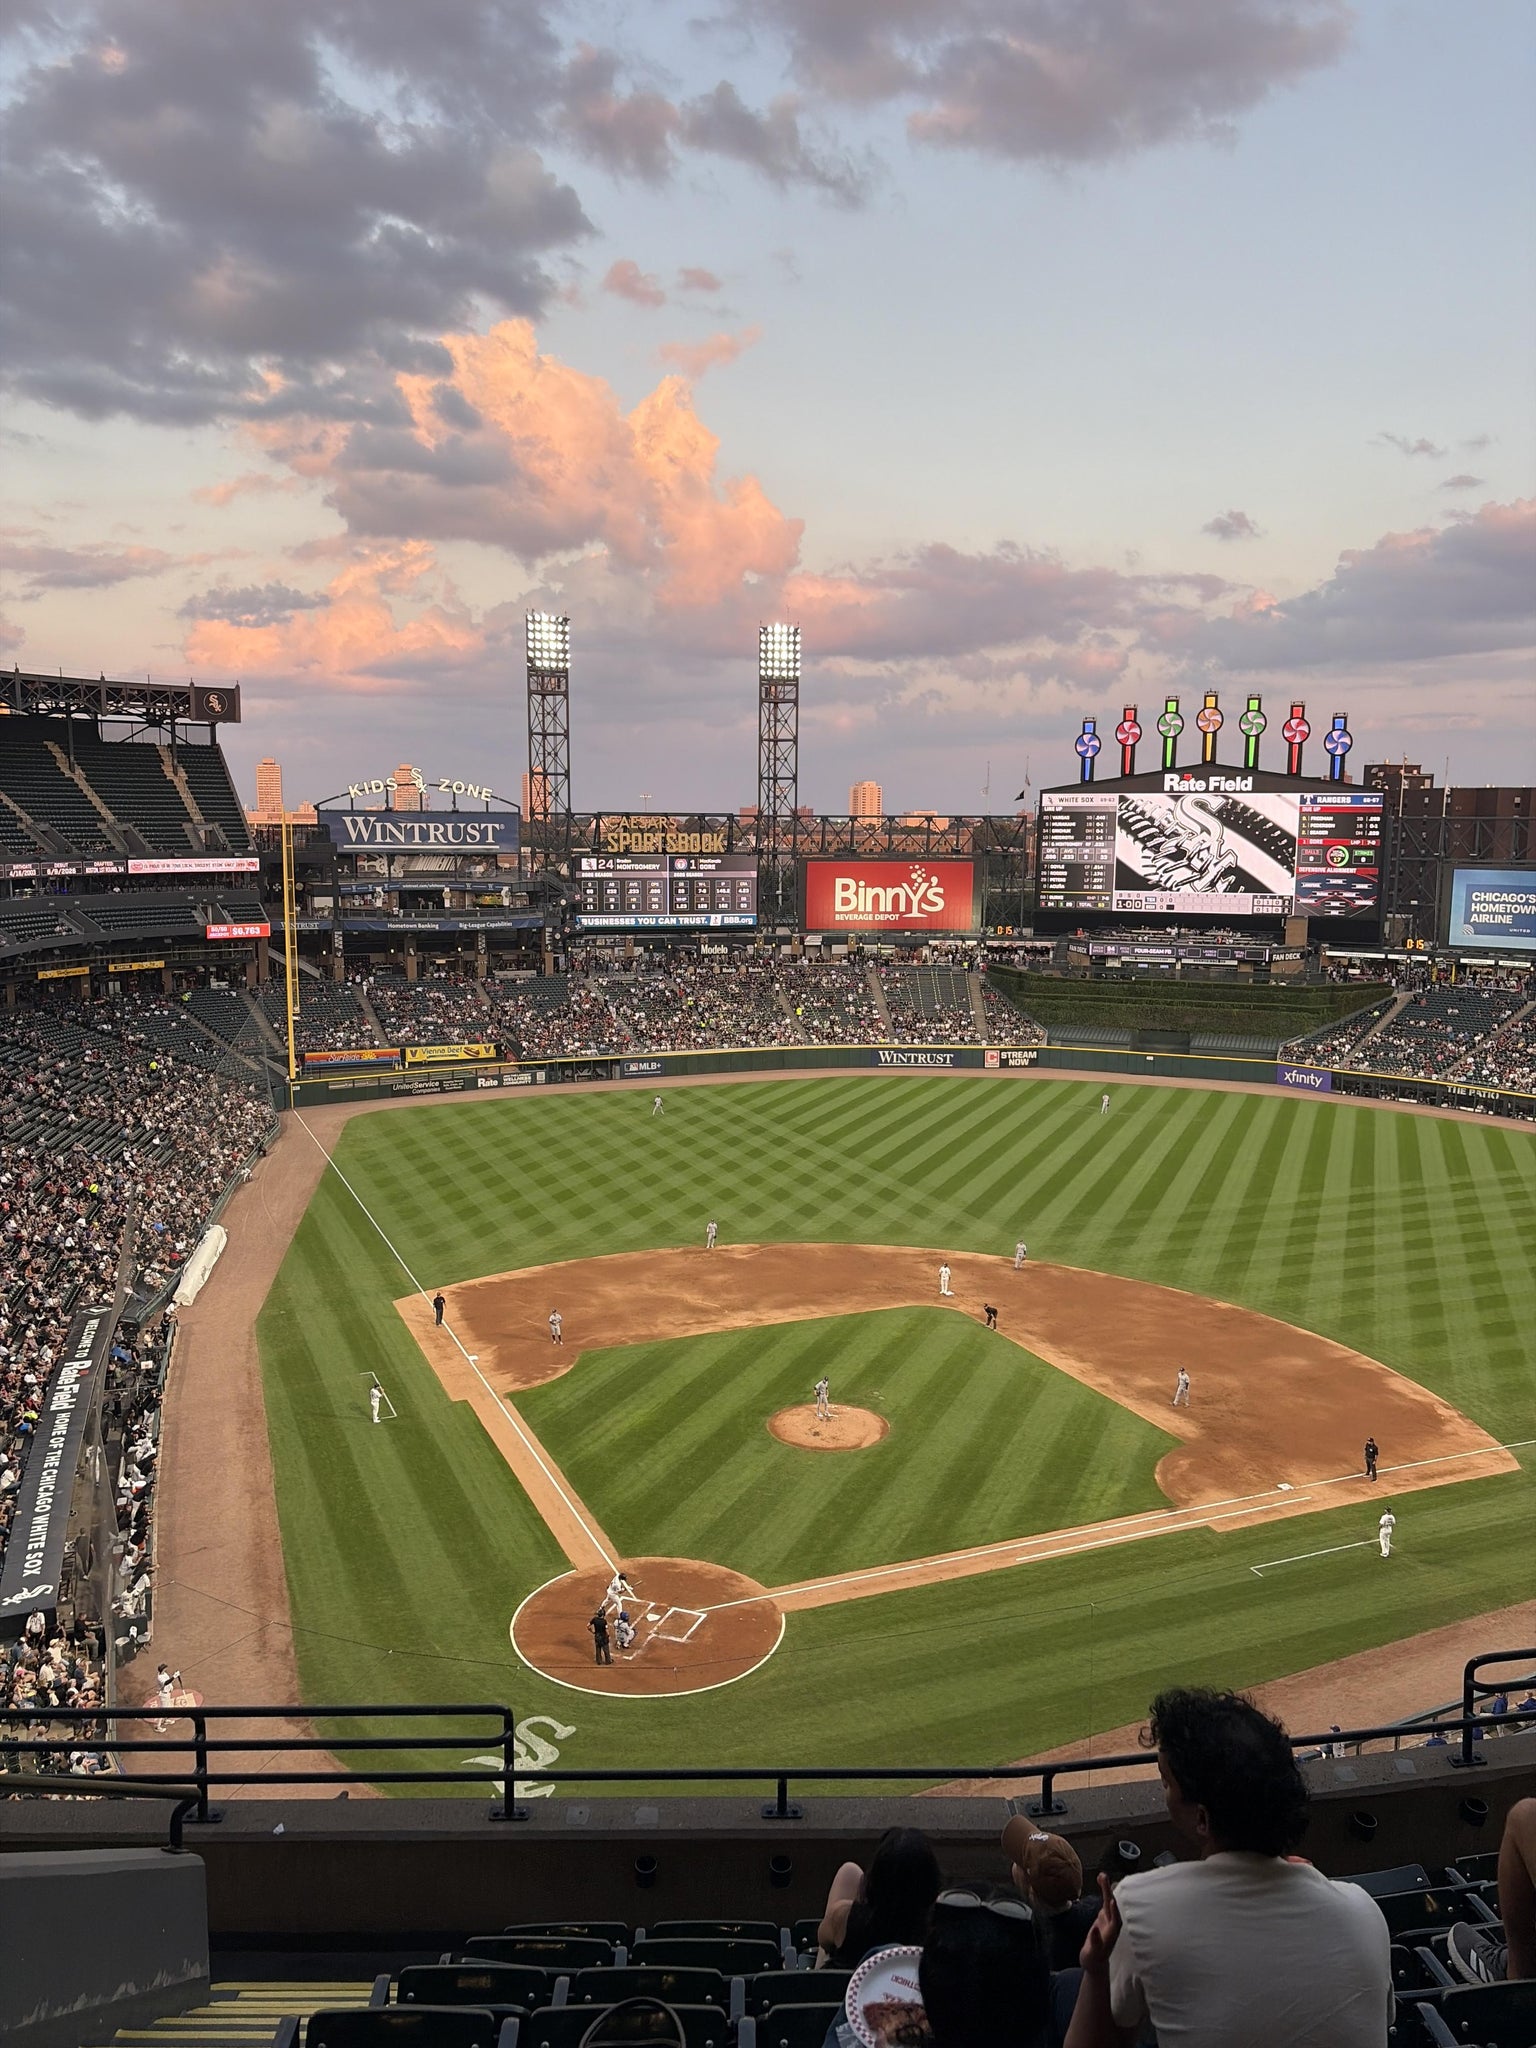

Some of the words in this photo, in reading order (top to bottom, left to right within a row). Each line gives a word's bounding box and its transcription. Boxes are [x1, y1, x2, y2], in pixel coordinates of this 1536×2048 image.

[349, 777, 398, 799] KIDS
[438, 778, 493, 802] ZONE
[1164, 774, 1207, 792] Rate
[1208, 776, 1253, 792] Field
[342, 816, 500, 844] WINTRUST
[608, 816, 678, 829] CAESARS
[608, 832, 726, 854] SPORTSBOOK
[598, 859, 614, 870] 24
[690, 860, 696, 870] 1
[1472, 892, 1536, 904] CHICAGO'S
[1470, 914, 1513, 924] AIRLINE
[701, 944, 728, 954] Modelo
[1406, 938, 1424, 950] 0:15
[640, 1062, 661, 1070] MLB+
[878, 1051, 954, 1064] WINTRUST
[478, 1078, 498, 1087] Rate
[1284, 1070, 1323, 1088] xfinity
[1446, 1086, 1467, 1095] THE
[1468, 1089, 1500, 1099] PATIO
[79, 1318, 100, 1349] WELCOME
[74, 1349, 90, 1358] TO
[57, 1360, 92, 1384] Rate
[50, 1384, 80, 1411] Field
[52, 1412, 71, 1437] HOME
[49, 1437, 65, 1449] OF
[43, 1449, 62, 1469] THE
[34, 1468, 58, 1513] CHICAGO
[27, 1513, 50, 1551] WHITE
[22, 1551, 44, 1577] SOX
